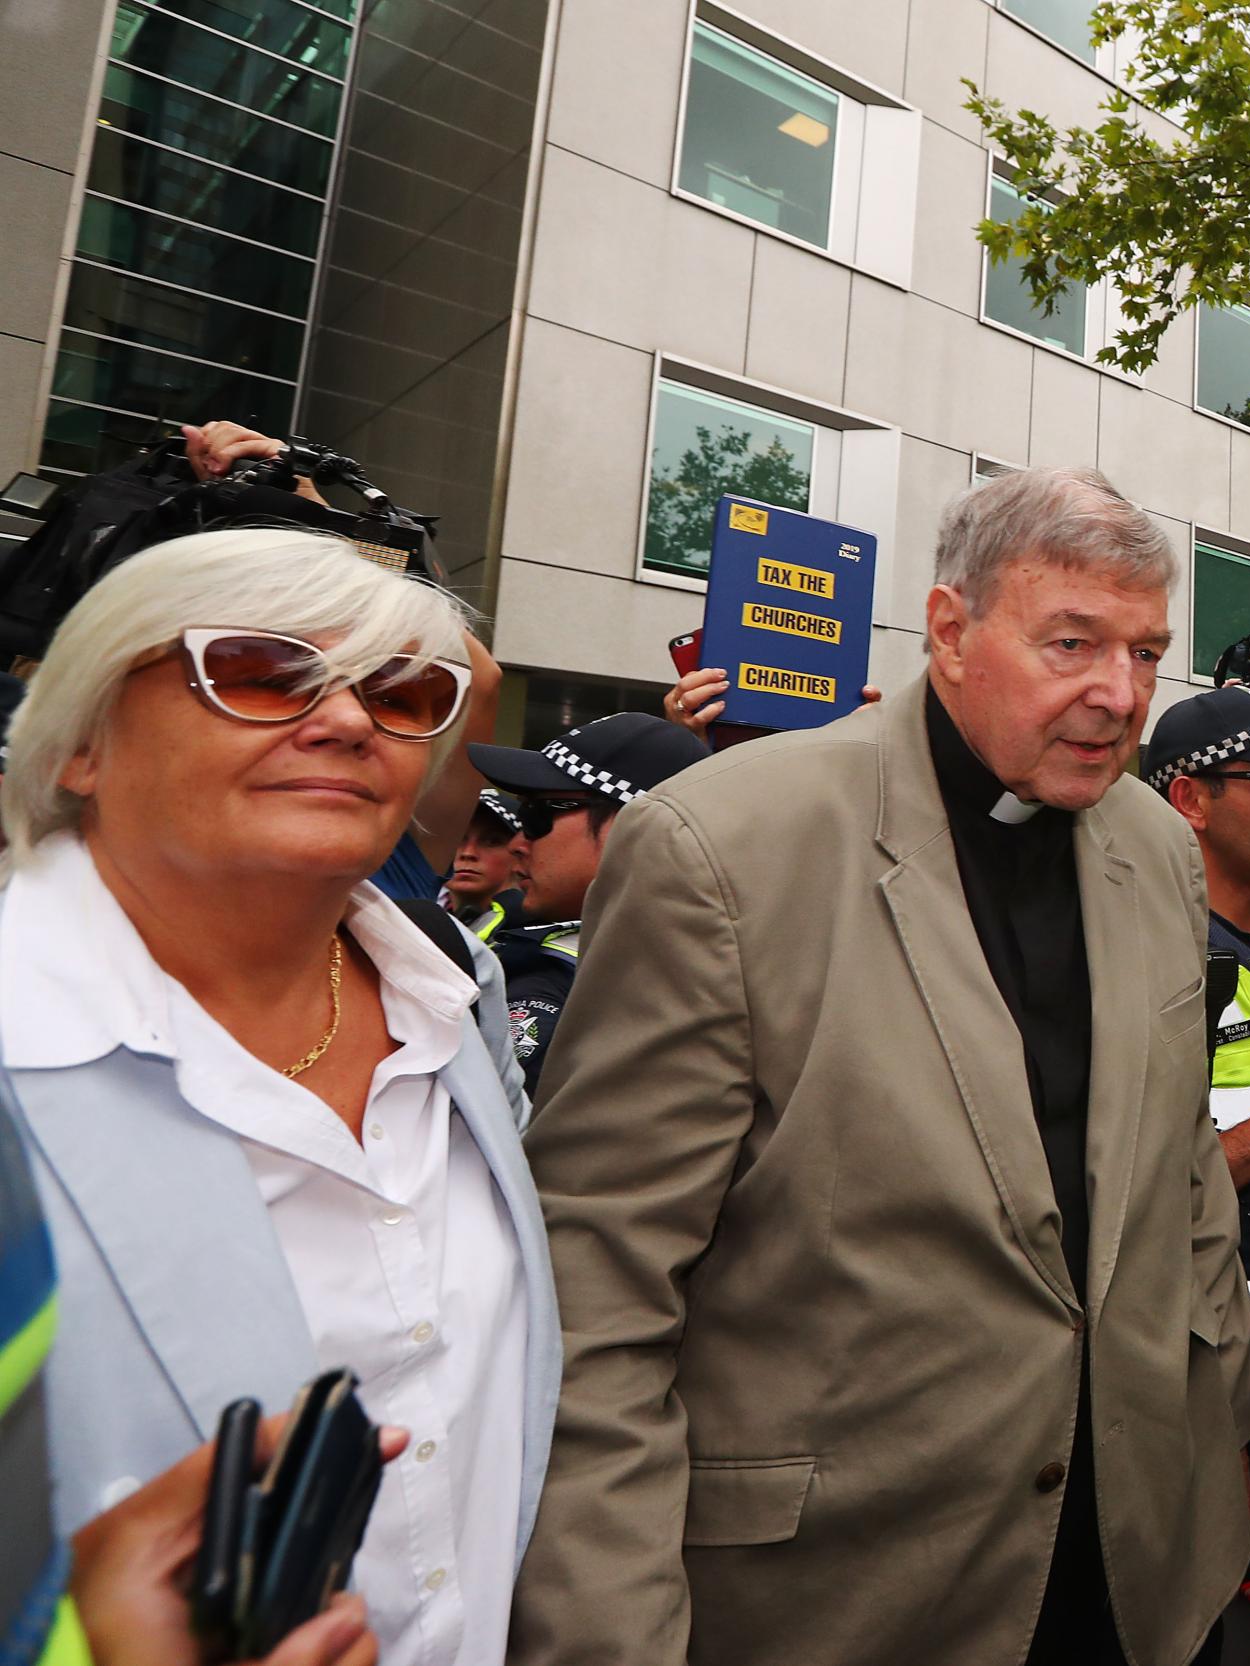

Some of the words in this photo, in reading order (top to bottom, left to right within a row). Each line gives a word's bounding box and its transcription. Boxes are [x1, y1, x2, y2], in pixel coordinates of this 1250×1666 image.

[762, 565, 792, 586] TAX
[798, 572, 826, 594] THE
[751, 605, 836, 638] CHURCHES
[745, 667, 830, 696] CHARITIES
[528, 1001, 559, 1014] POLICE
[1224, 1023, 1248, 1036] McRoy
